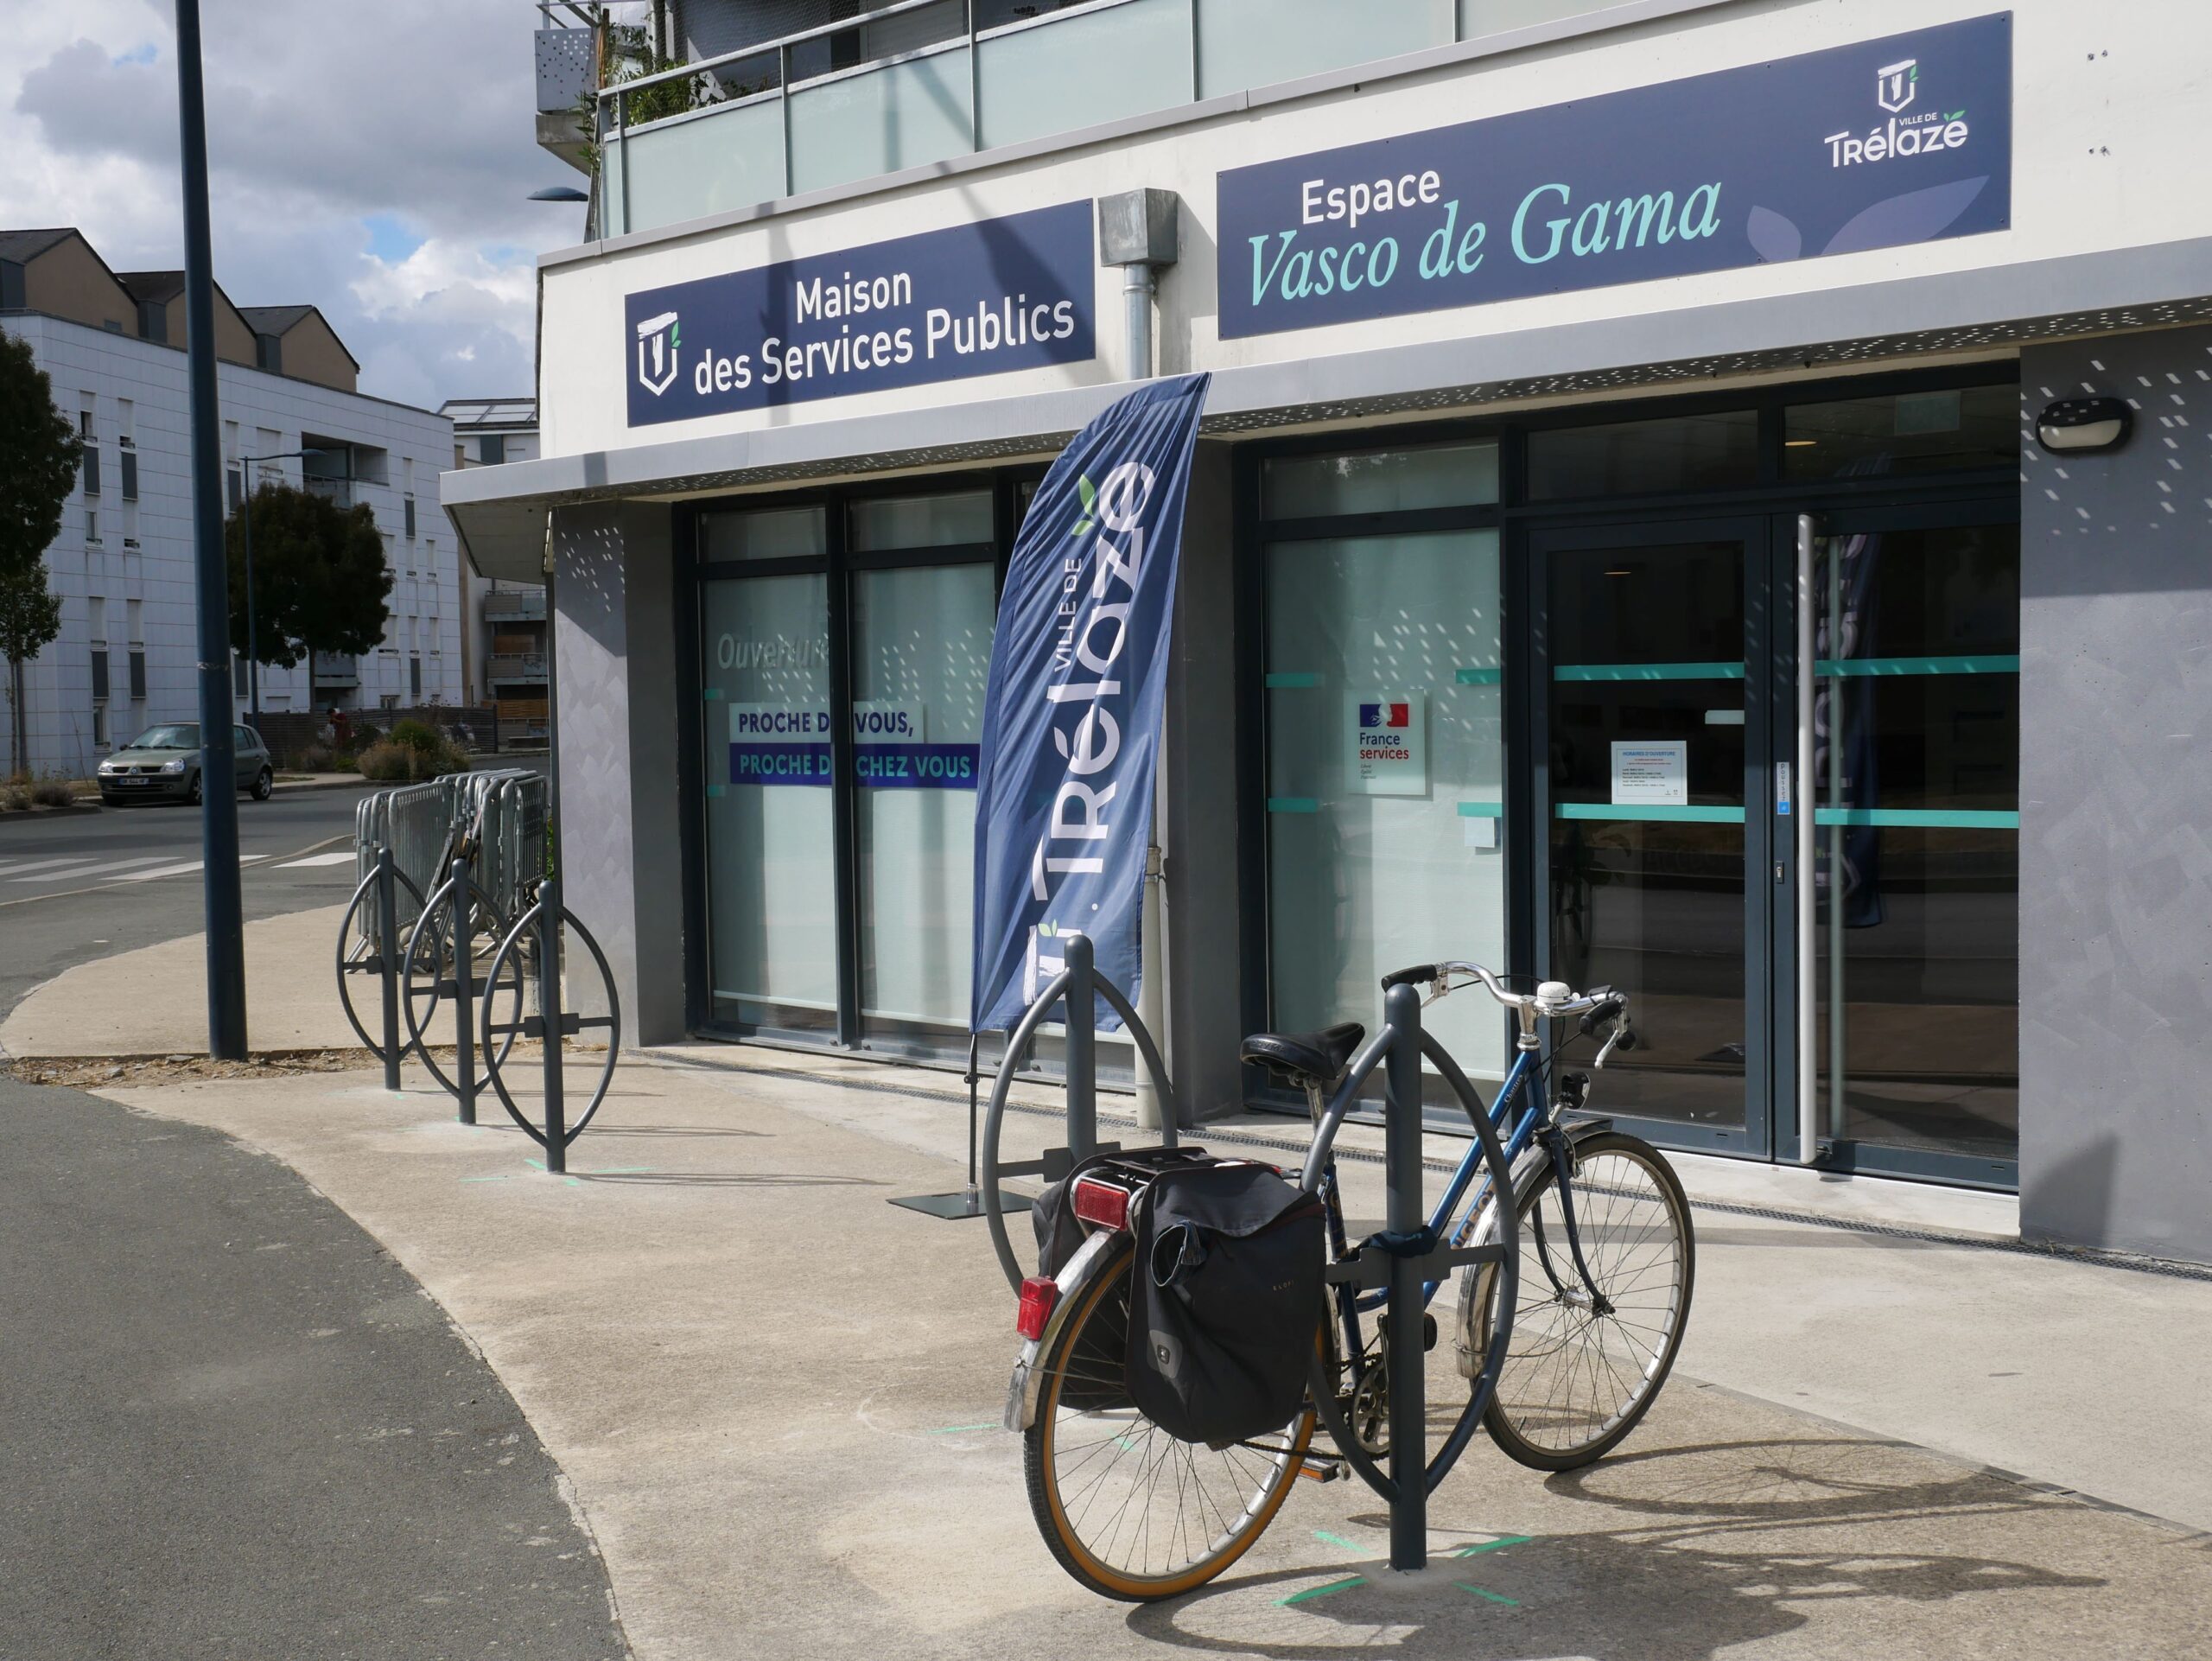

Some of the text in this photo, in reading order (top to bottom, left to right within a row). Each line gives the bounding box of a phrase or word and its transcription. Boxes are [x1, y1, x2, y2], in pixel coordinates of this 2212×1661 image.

[1898, 111, 1938, 126] VILLE DE
[1301, 169, 1441, 228] Espace
[1249, 180, 1722, 307] Vasco de Gama
[796, 271, 912, 324] Maison
[695, 294, 1075, 395] des Services Publics
[1054, 557, 1082, 672] VILLE DE
[739, 711, 913, 737] PROCHE D VOUS,
[1359, 732, 1401, 745] France
[740, 754, 970, 778] PROCHE D CHEZ VOUS
[1359, 746, 1409, 760] services
